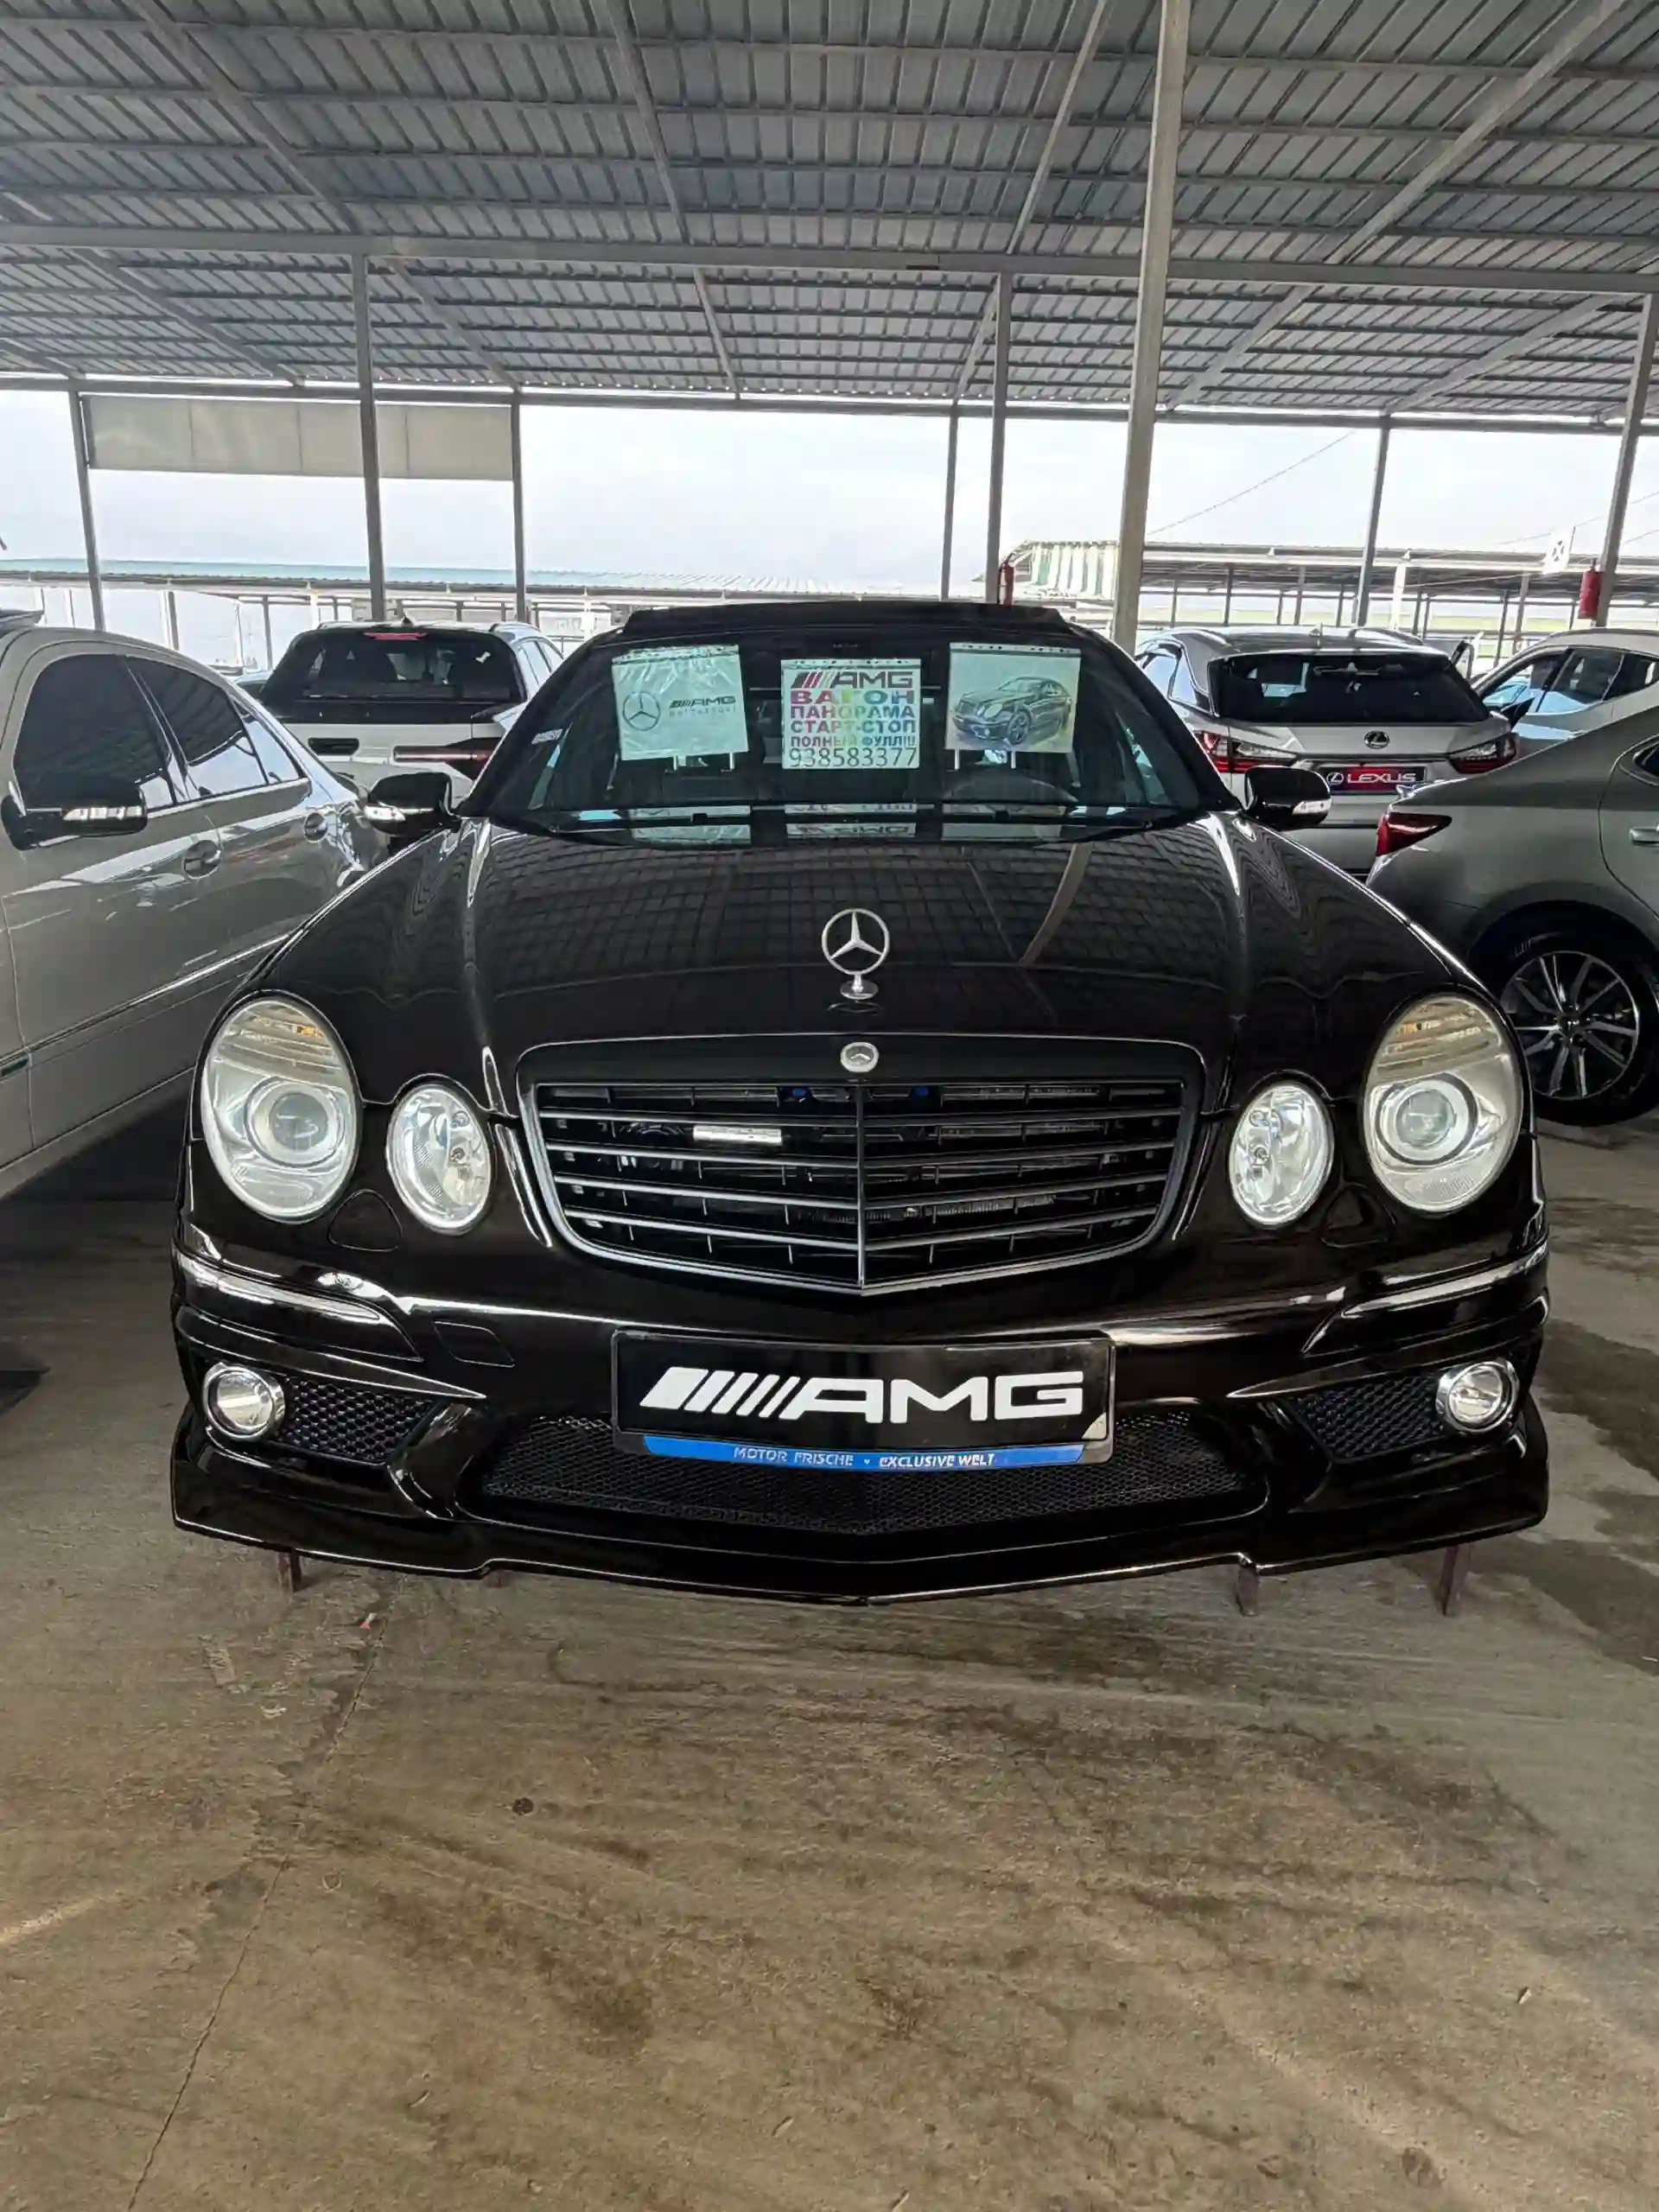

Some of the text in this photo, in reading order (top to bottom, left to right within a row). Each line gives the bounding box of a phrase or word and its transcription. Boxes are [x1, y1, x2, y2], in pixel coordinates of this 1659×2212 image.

[829, 671, 913, 689] AMG
[791, 690, 915, 704] ВАГОН
[790, 705, 915, 719] ПАНОРАМА
[791, 720, 916, 734] СТАРТ-СТОП
[789, 747, 917, 767] 938583377
[1347, 772, 1416, 784] LEXUS
[779, 1370, 1084, 1423] AMG
[734, 1446, 788, 1462] MOTOR
[879, 1454, 956, 1467] EXCLUSIVE
[958, 1453, 995, 1466] WELT
